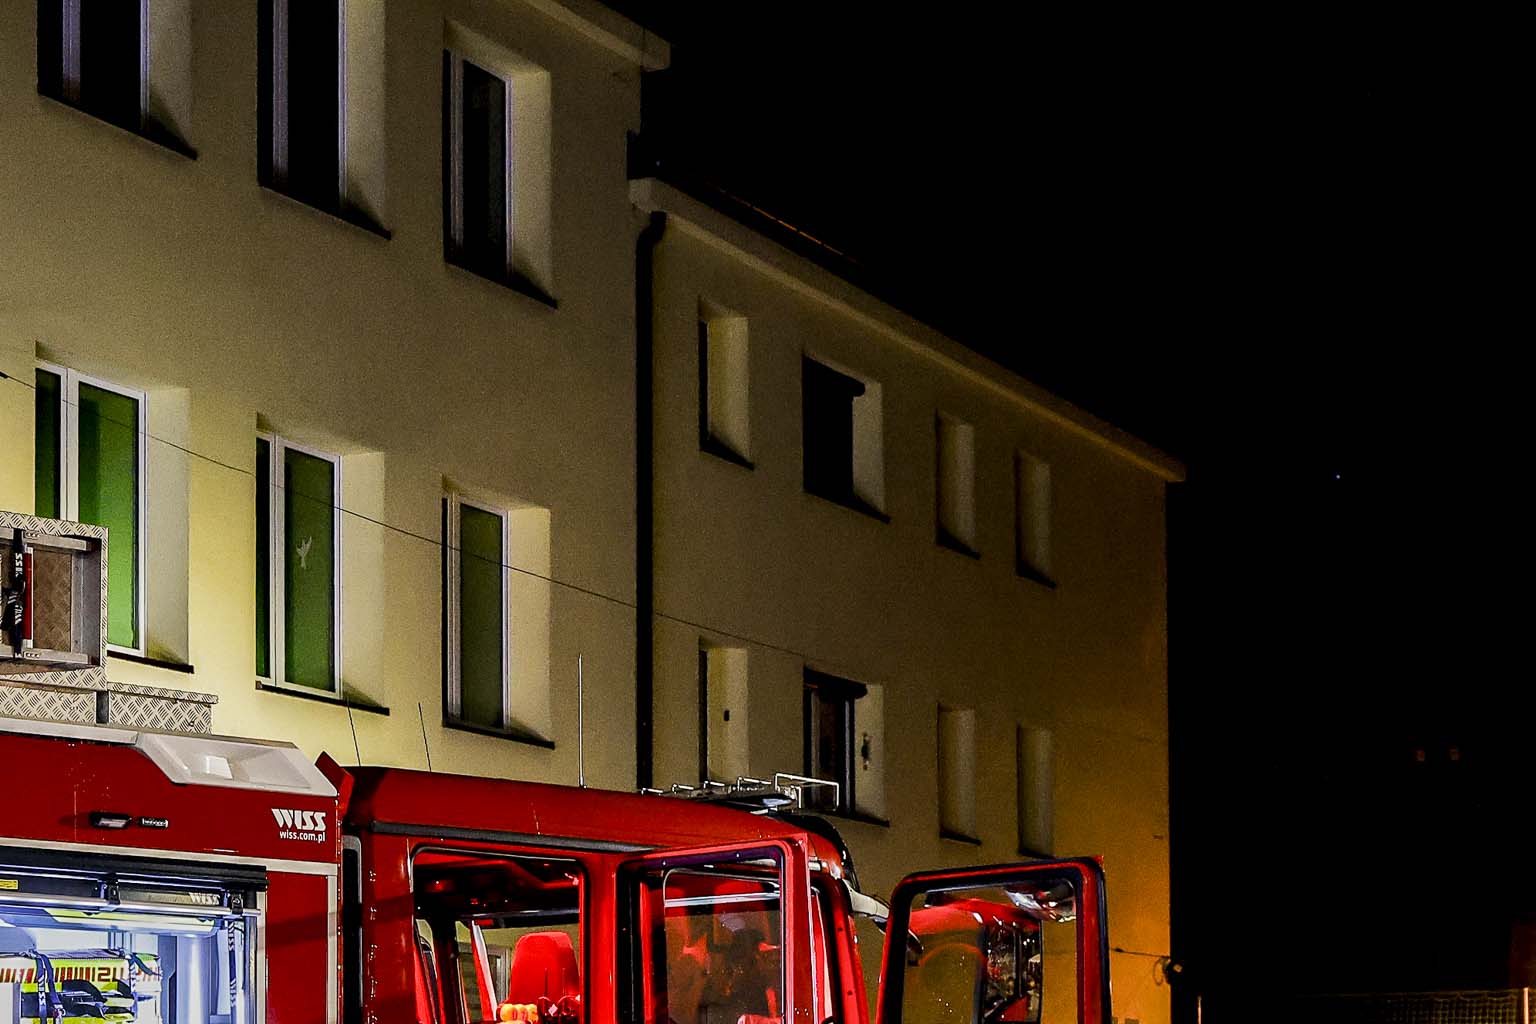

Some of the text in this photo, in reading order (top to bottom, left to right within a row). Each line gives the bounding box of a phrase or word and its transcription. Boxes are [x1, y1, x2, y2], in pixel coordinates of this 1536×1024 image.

[271, 808, 326, 831] WISS
[279, 830, 326, 844] wiss.com.pl
[188, 891, 220, 905] WISS
